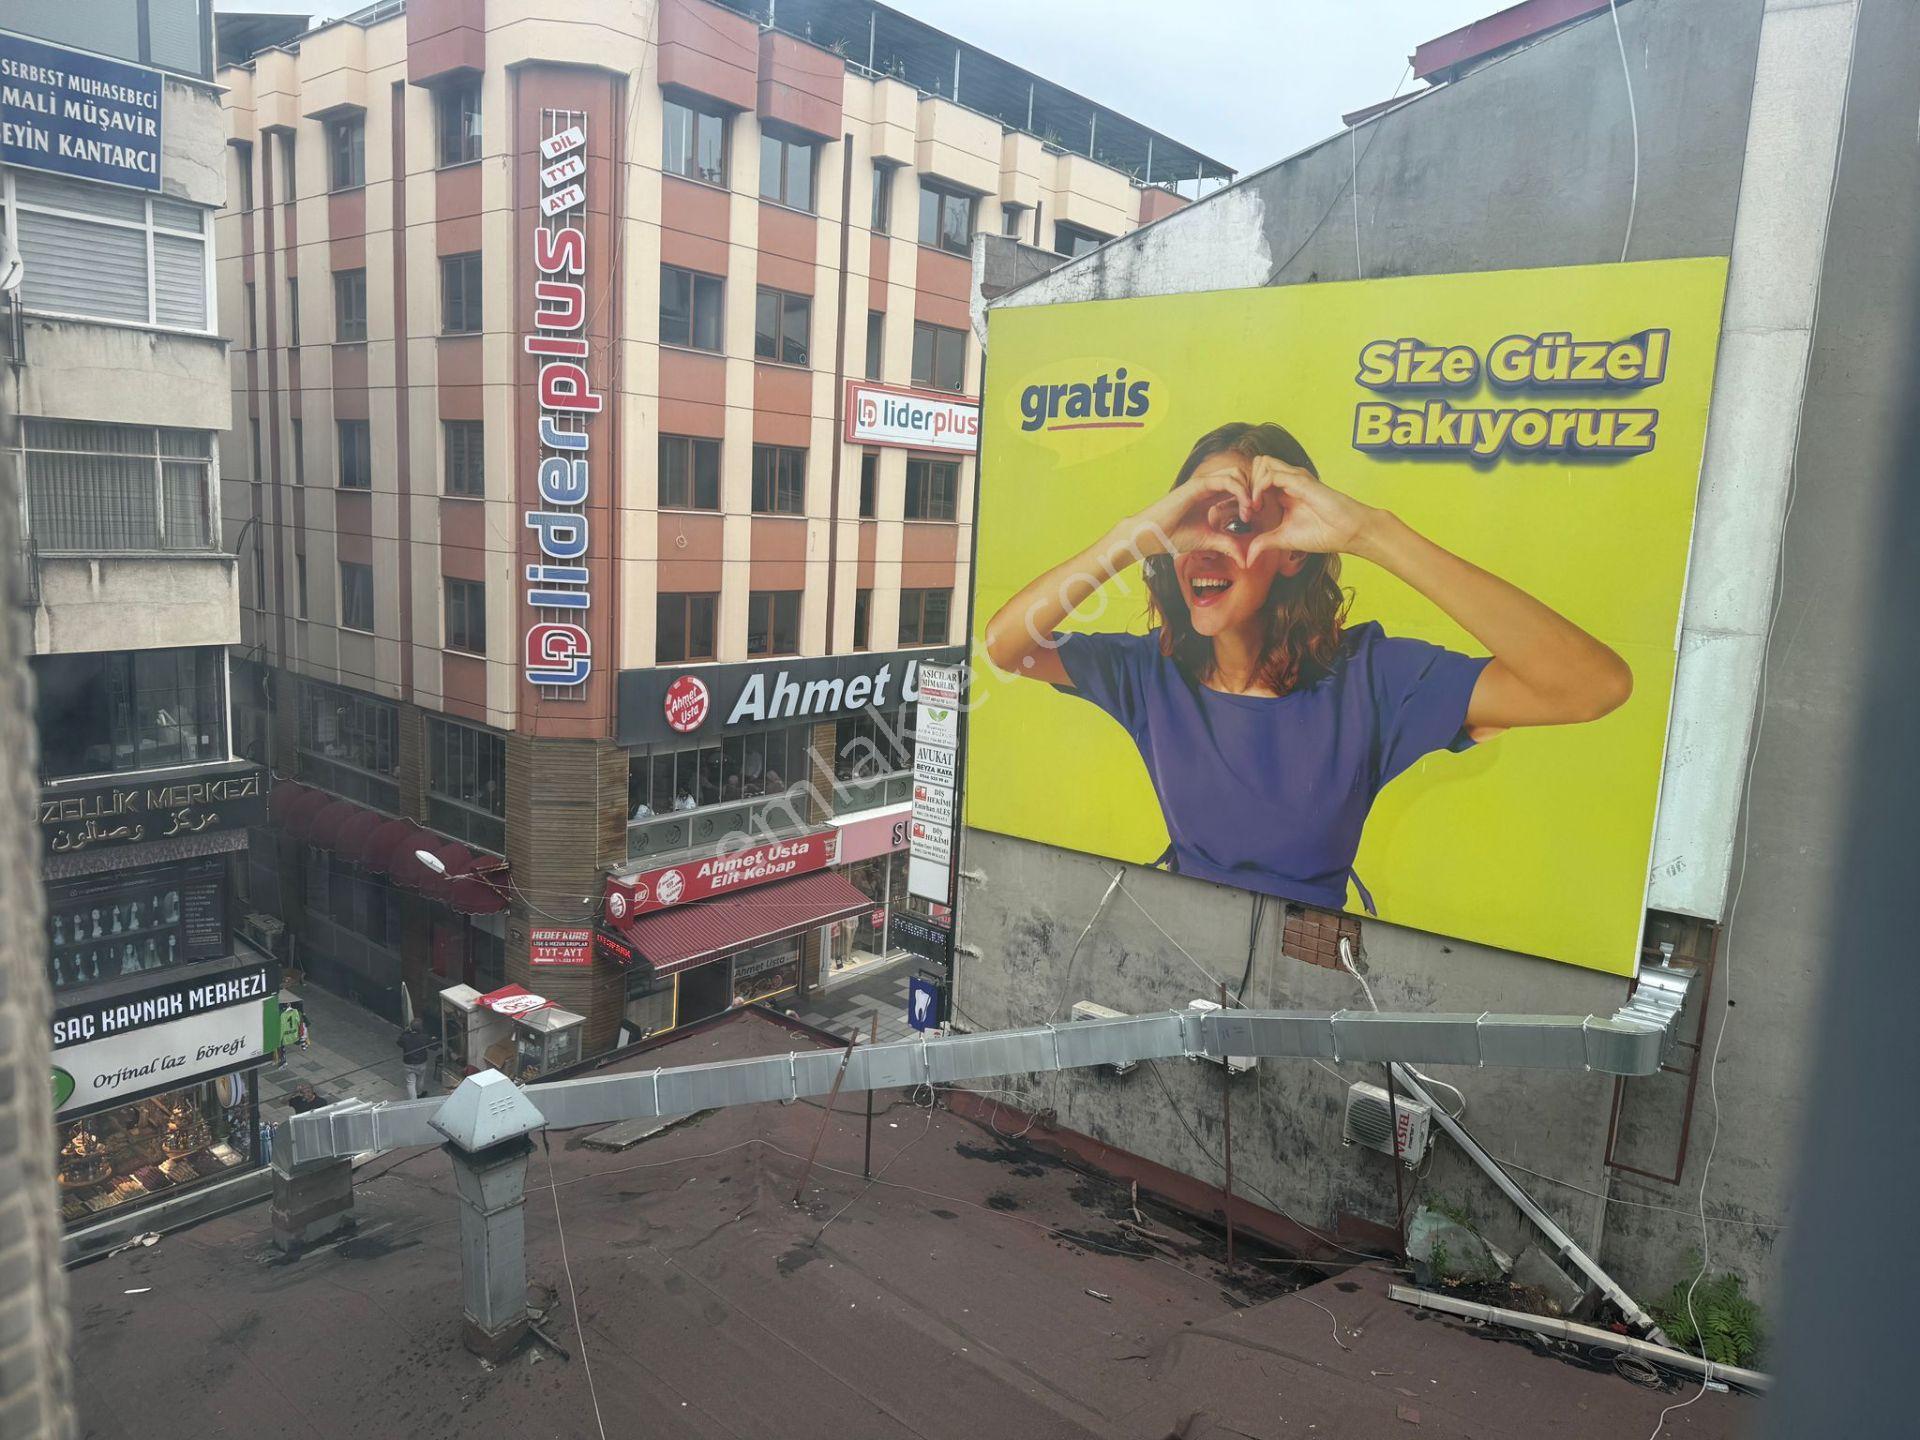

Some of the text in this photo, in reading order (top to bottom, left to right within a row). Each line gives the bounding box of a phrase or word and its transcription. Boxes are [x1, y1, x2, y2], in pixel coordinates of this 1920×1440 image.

[1, 58, 157, 110] SERBEST MUHASEBECİ
[2, 85, 157, 138] MALİ MÜŞAVİR
[0, 120, 157, 174] EYİN KANTARCI
[551, 135, 577, 154] DİL
[547, 160, 576, 182] TYT
[549, 189, 576, 211] AYT
[1357, 329, 1669, 389] Size Güzel
[524, 226, 603, 609] liderplus
[1020, 367, 1150, 432] gratis
[883, 399, 978, 437] liderplus
[1354, 400, 1658, 460] Bakıyoruz
[671, 686, 698, 714] Ahmet
[726, 663, 892, 725] Ahmet
[681, 704, 699, 724] Usta
[916, 763, 953, 777] BEYZA KAYA
[917, 747, 954, 766] AVUKAT
[33, 772, 260, 824] ZELLİK MERKEZİ
[934, 788, 945, 799] DİŞ
[697, 851, 764, 878] Ahmet
[768, 843, 809, 860] Usta
[710, 860, 796, 889] Elit Kebap
[538, 948, 584, 957] TYT-AYT
[53, 968, 267, 1044] SAÇ KAYNAK MERKEZİ
[287, 1016, 293, 1029] 1
[93, 1035, 246, 1090] Orjinal laz böreği
